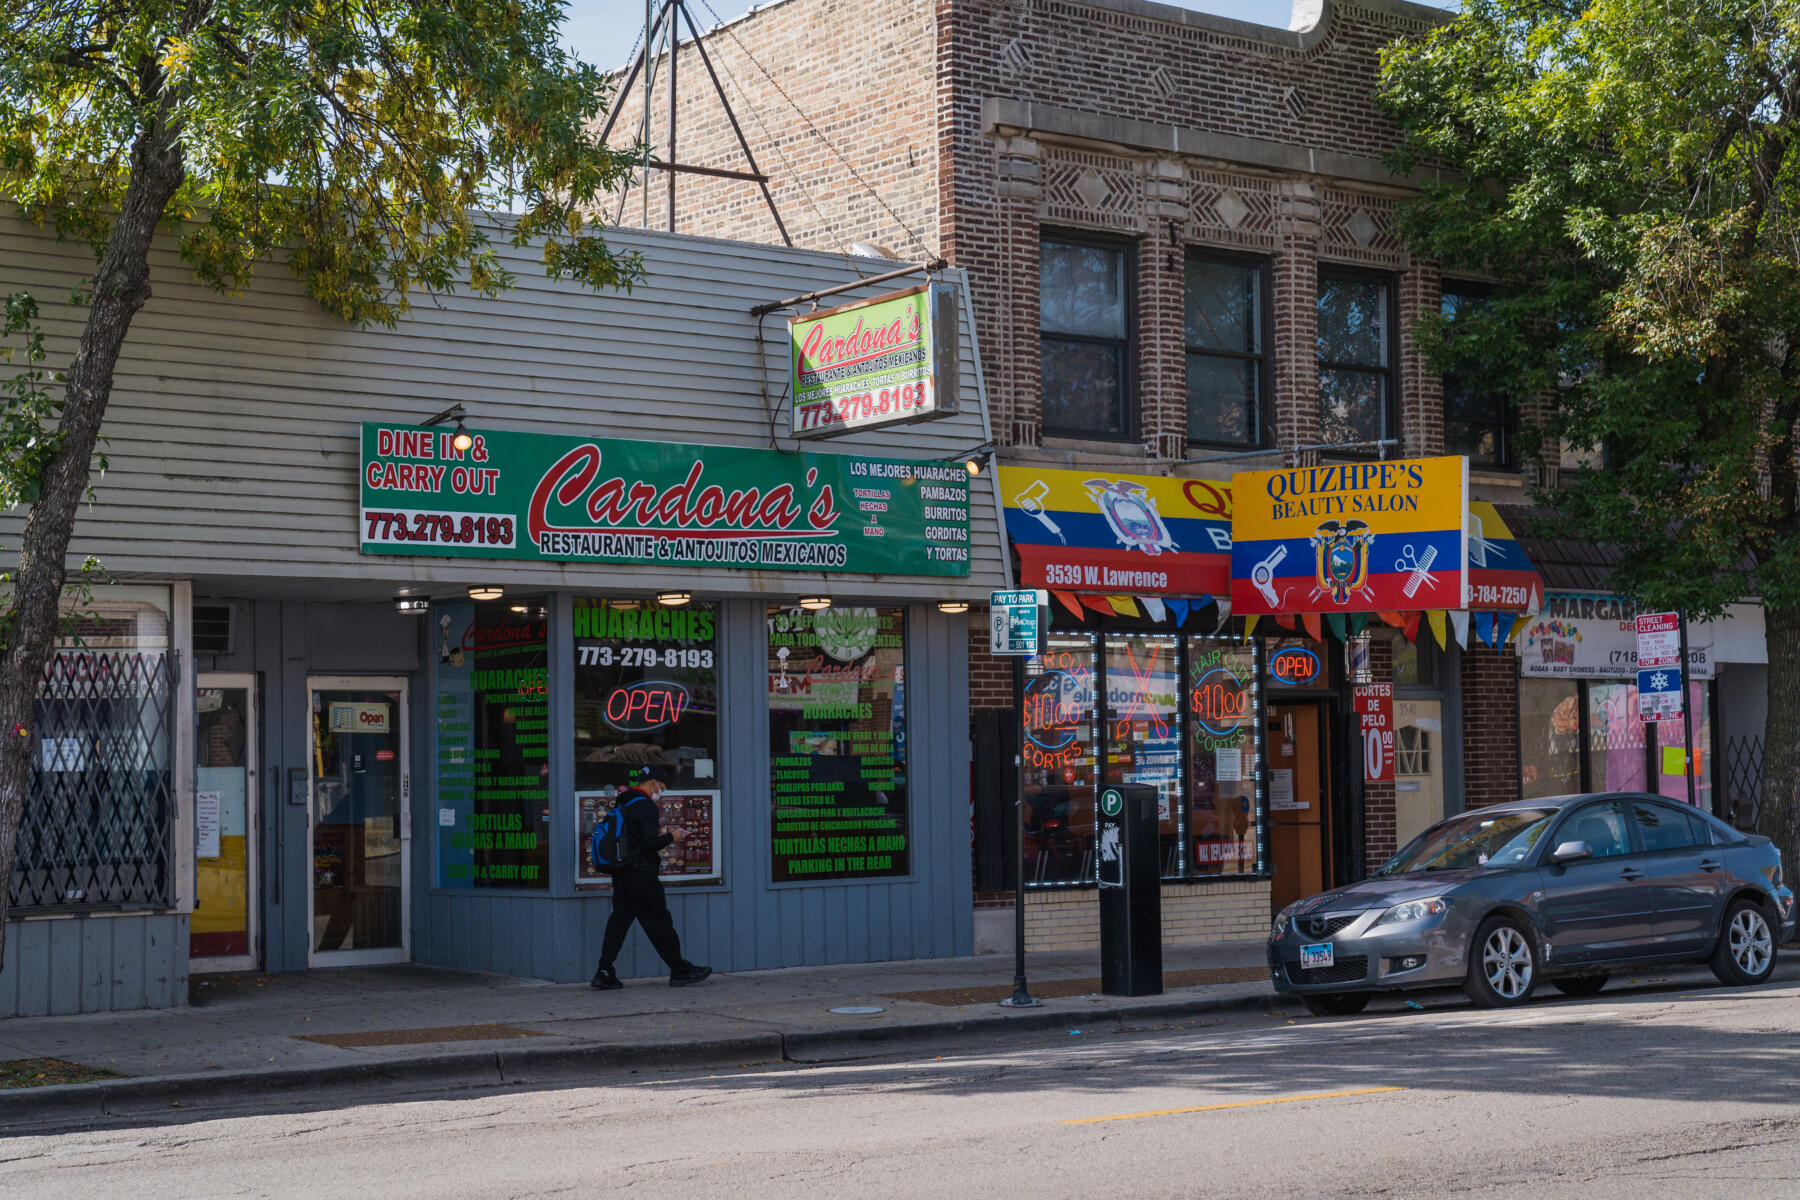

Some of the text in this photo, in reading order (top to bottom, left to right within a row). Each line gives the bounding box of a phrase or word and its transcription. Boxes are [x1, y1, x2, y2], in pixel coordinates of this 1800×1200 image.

[797, 304, 922, 382] Cardona's
[801, 348, 926, 388] RESTAURANTE & ANTOJITOS MEXICANOS
[795, 392, 806, 403] LOS
[807, 386, 833, 400] MEJORES
[872, 374, 895, 389] TORTAS
[901, 366, 930, 381] BURRITOS
[800, 381, 926, 429] 773.279.8193
[378, 429, 434, 459] DINE
[471, 435, 489, 462] &
[366, 461, 500, 495] CARRY OUT
[850, 462, 967, 482] LOS MEJORES HUARACHES
[1266, 464, 1424, 502] QUIZHPE'S
[528, 444, 841, 545] Cardona's
[854, 488, 890, 500] TORTILLAS
[920, 486, 967, 502] PAMBAZOS
[859, 502, 888, 512] HECHAS
[924, 506, 967, 521] BURRITOS
[1272, 494, 1419, 520] BEAUTY SALON
[871, 514, 877, 524] A
[365, 512, 513, 545] 773.279.8193
[863, 527, 885, 537] MANO
[925, 527, 968, 541] GORDITAS
[540, 531, 846, 566] RESTAURANTE & ANTOJITOS MEXICANOS
[926, 547, 968, 561] Y TORTAS
[1045, 563, 1168, 588] 3539 W. Lawrence
[994, 594, 1034, 604] PAY TO PARK
[1467, 586, 1527, 605] 3-784-7250
[574, 607, 714, 640] HUARACHES
[1639, 616, 1662, 625] STREET
[1639, 622, 1674, 632] CLEANING
[769, 632, 794, 647] PARA
[797, 633, 821, 647] TODO
[578, 646, 713, 668] 773-279-8193
[1660, 656, 1676, 664] ZONE
[1275, 656, 1314, 677] OPEN
[1569, 666, 1595, 674] SHOWERS
[470, 667, 548, 691] HUARACHES
[1355, 685, 1391, 697] CORTES
[607, 689, 684, 723] OPEN
[803, 703, 872, 719] HUARACHES
[1367, 699, 1380, 711] DE
[360, 712, 384, 724] Open
[1362, 714, 1386, 726] PELO
[465, 814, 522, 831] TORTILLAS
[496, 833, 503, 849] A
[505, 832, 537, 849] MANO
[773, 835, 905, 855] TORTILLAS HECHAS A MANO
[489, 864, 520, 879] CARRY
[521, 865, 540, 879] OUT
[788, 855, 892, 874] PARKING IN THE REAR
